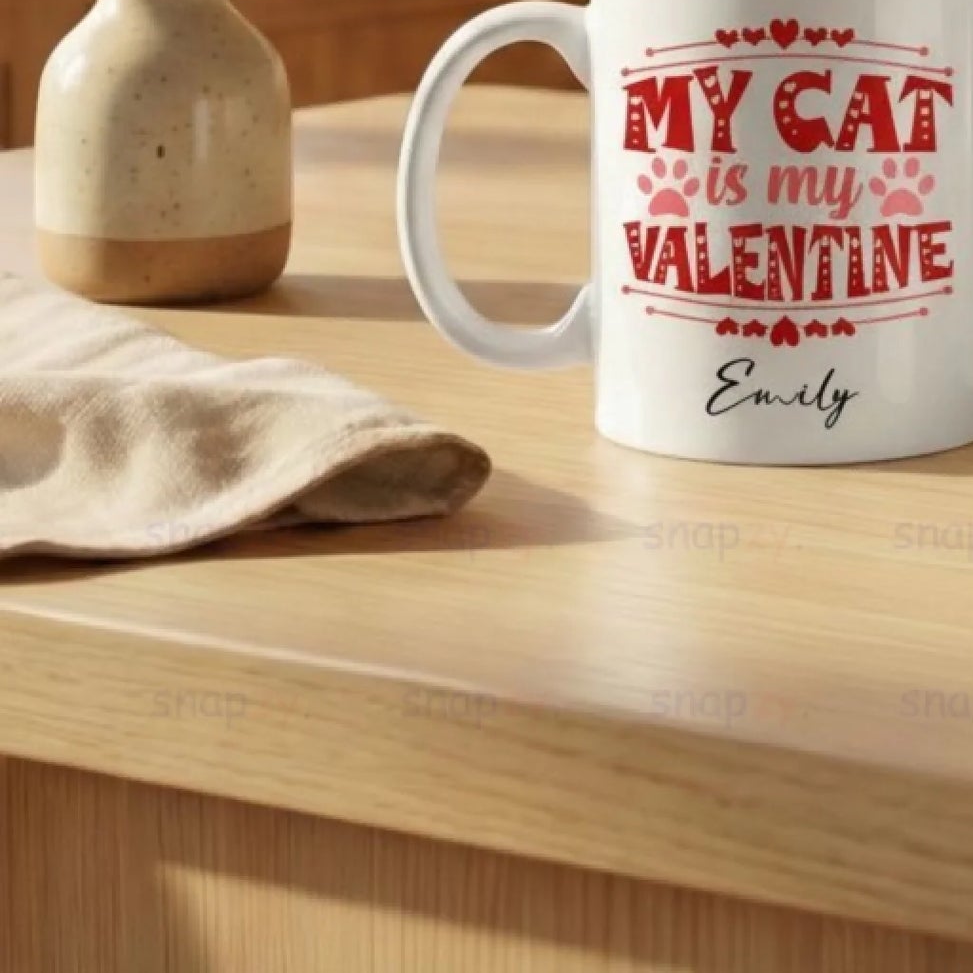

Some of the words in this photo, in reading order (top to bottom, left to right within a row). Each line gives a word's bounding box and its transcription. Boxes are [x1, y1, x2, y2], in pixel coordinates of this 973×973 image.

[622, 66, 753, 154] MY
[772, 69, 954, 153] CAT
[706, 156, 748, 207] is
[767, 163, 863, 220] my
[622, 221, 954, 302] VALENTINE
[705, 358, 859, 430] Emily
